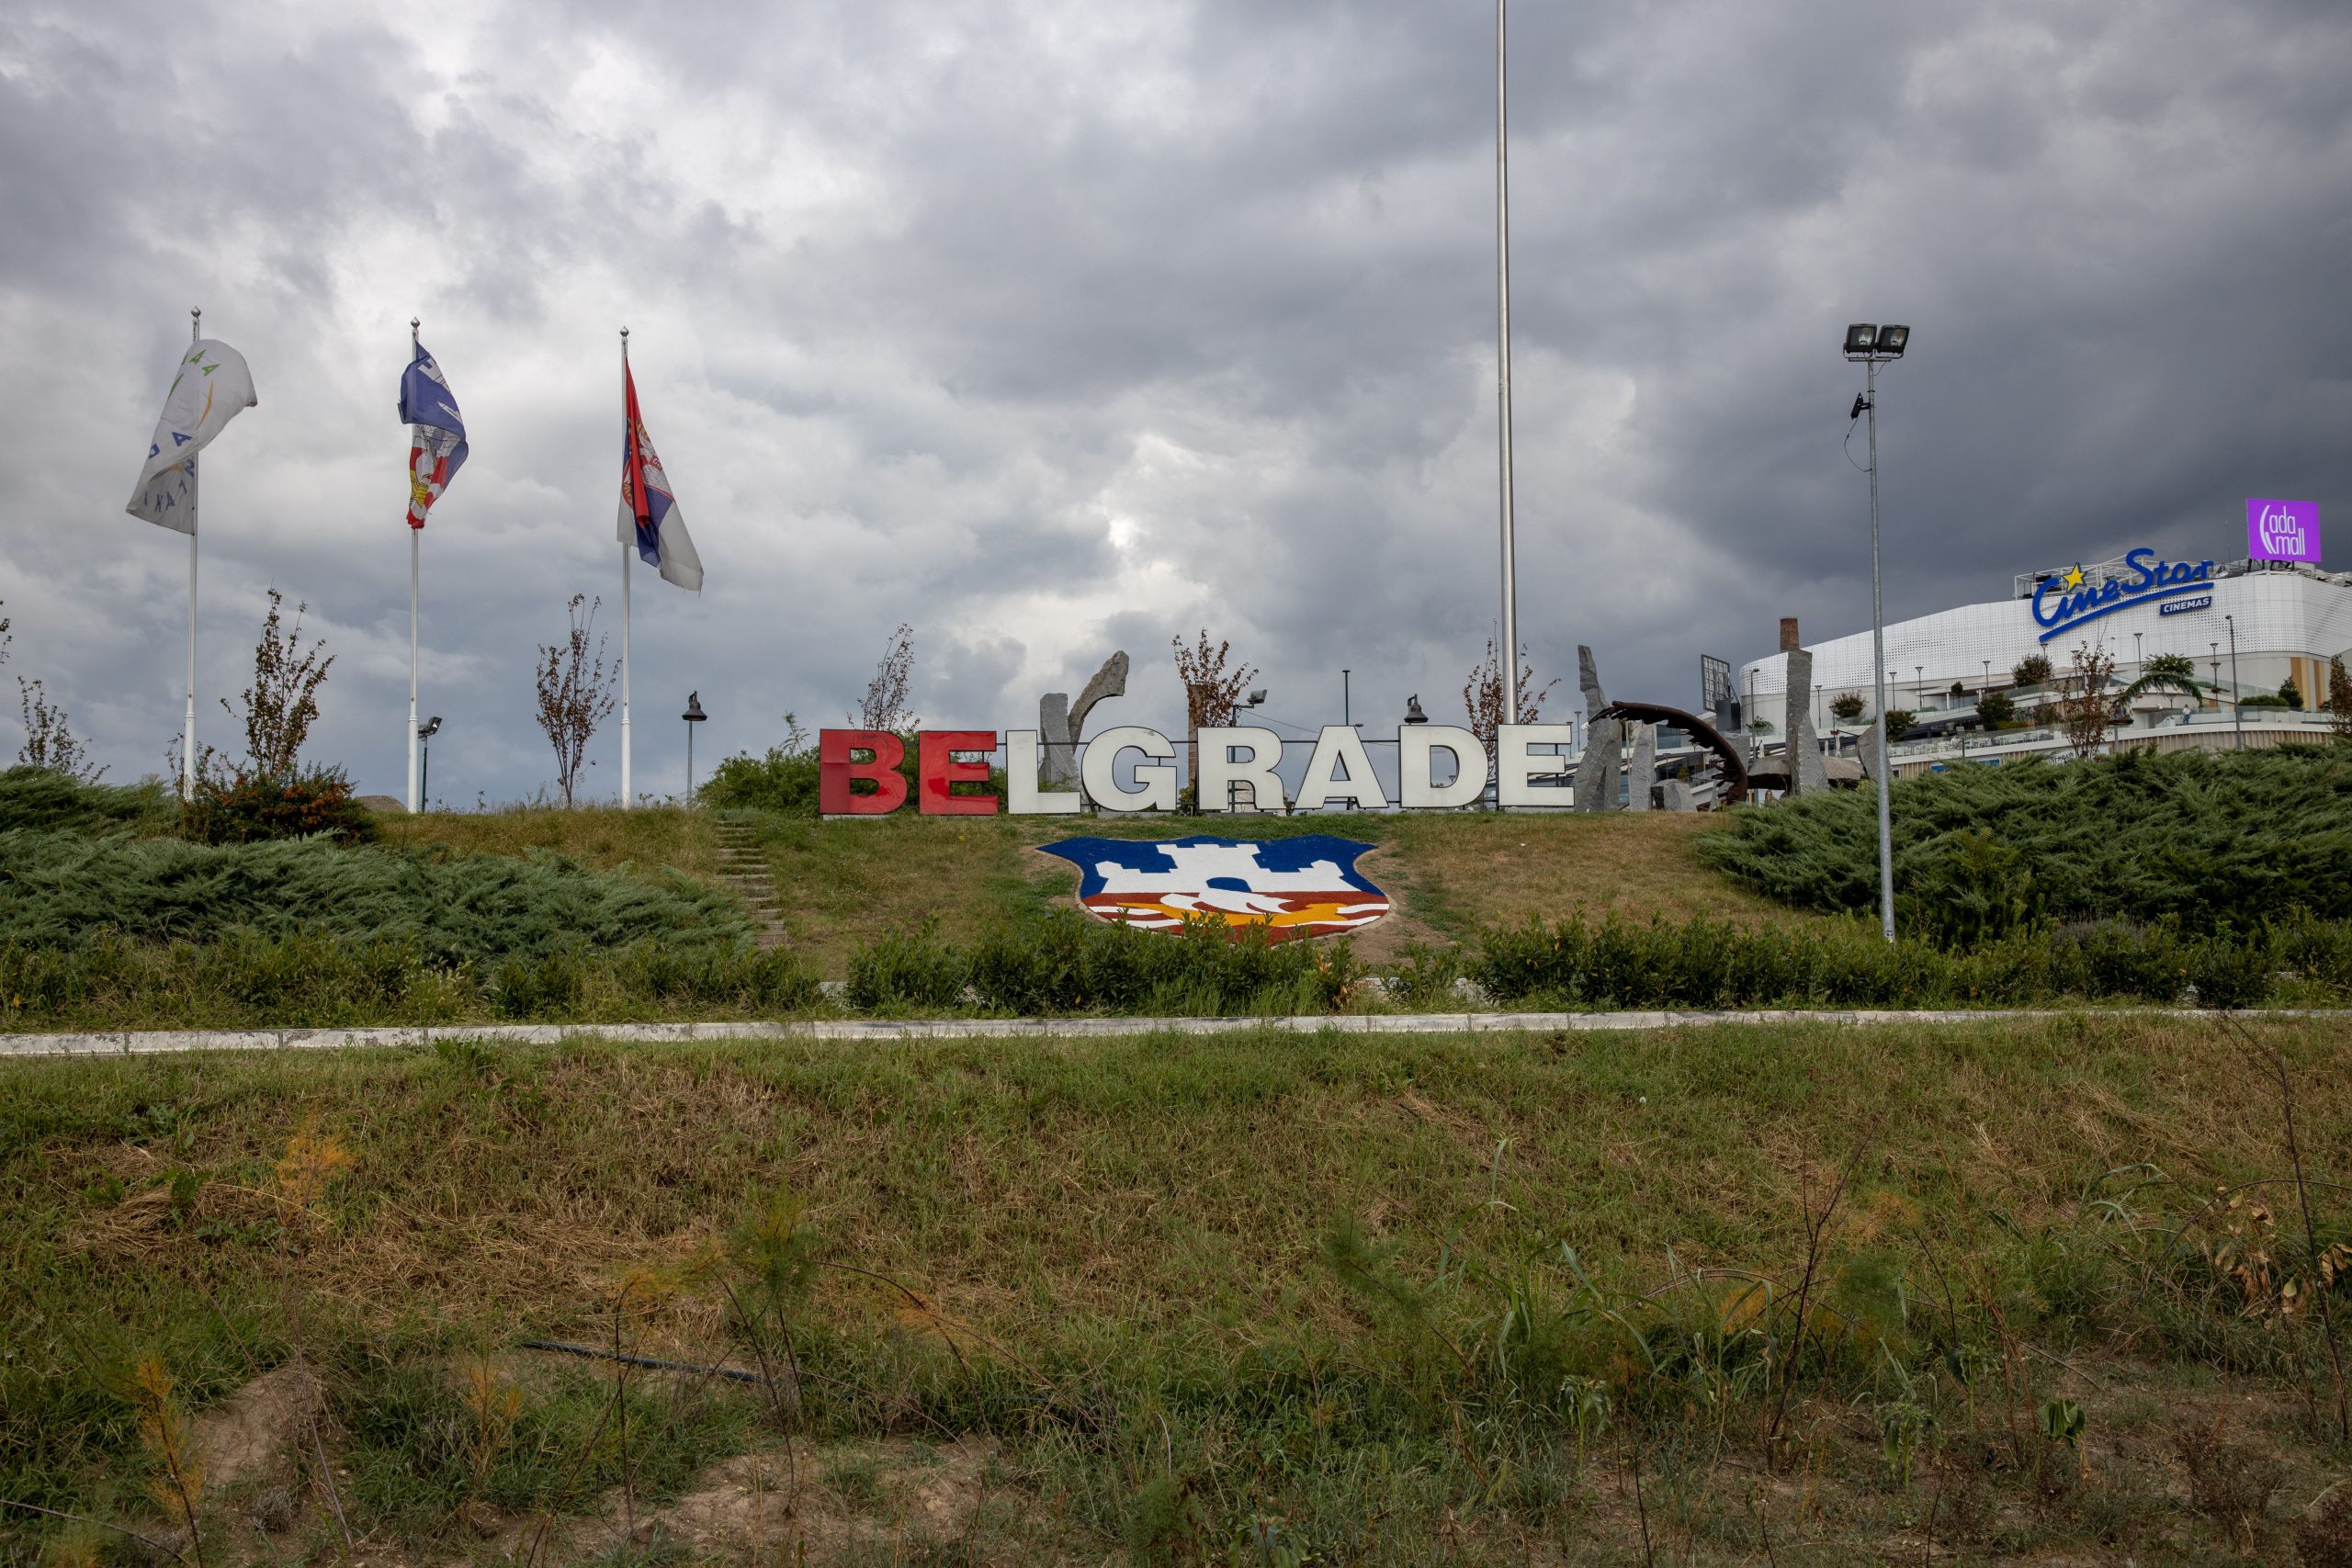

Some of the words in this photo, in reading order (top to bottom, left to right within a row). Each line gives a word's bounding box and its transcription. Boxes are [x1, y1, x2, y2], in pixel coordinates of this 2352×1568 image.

[2268, 505, 2297, 535] ada
[2275, 527, 2306, 556] mall
[2163, 597, 2211, 613] CINEMAS
[819, 723, 1576, 816] BELGRADE
